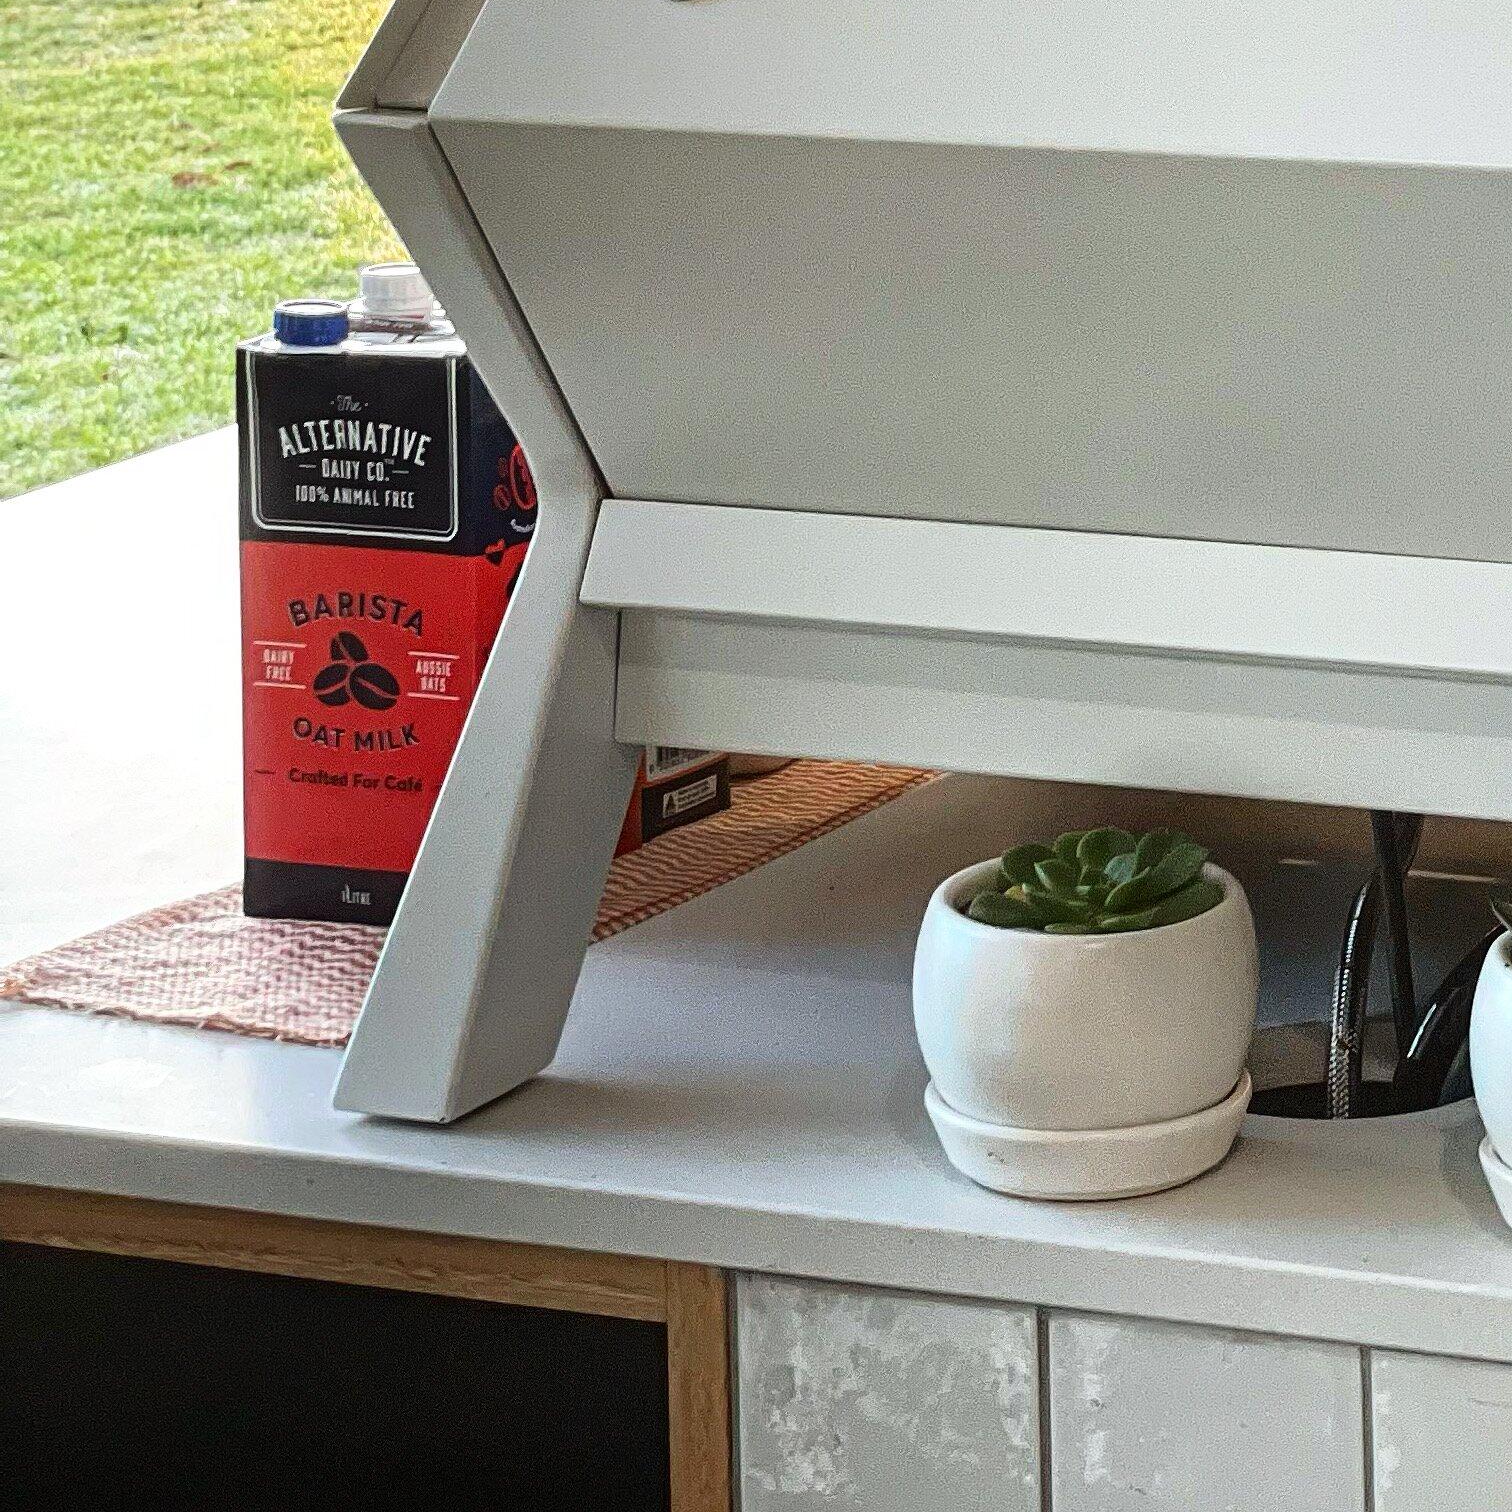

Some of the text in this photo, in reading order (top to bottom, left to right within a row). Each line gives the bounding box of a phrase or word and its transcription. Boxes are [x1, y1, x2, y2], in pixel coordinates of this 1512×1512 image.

[336, 394, 363, 413] The
[278, 419, 432, 467] ALTERNATIVE
[321, 458, 360, 480] DAIRY
[295, 485, 415, 509] 100% ANIMAL FREE
[289, 592, 424, 637] BARISTA
[292, 716, 421, 752] OAT MILK
[288, 767, 348, 787] Crafted
[353, 773, 381, 788] For
